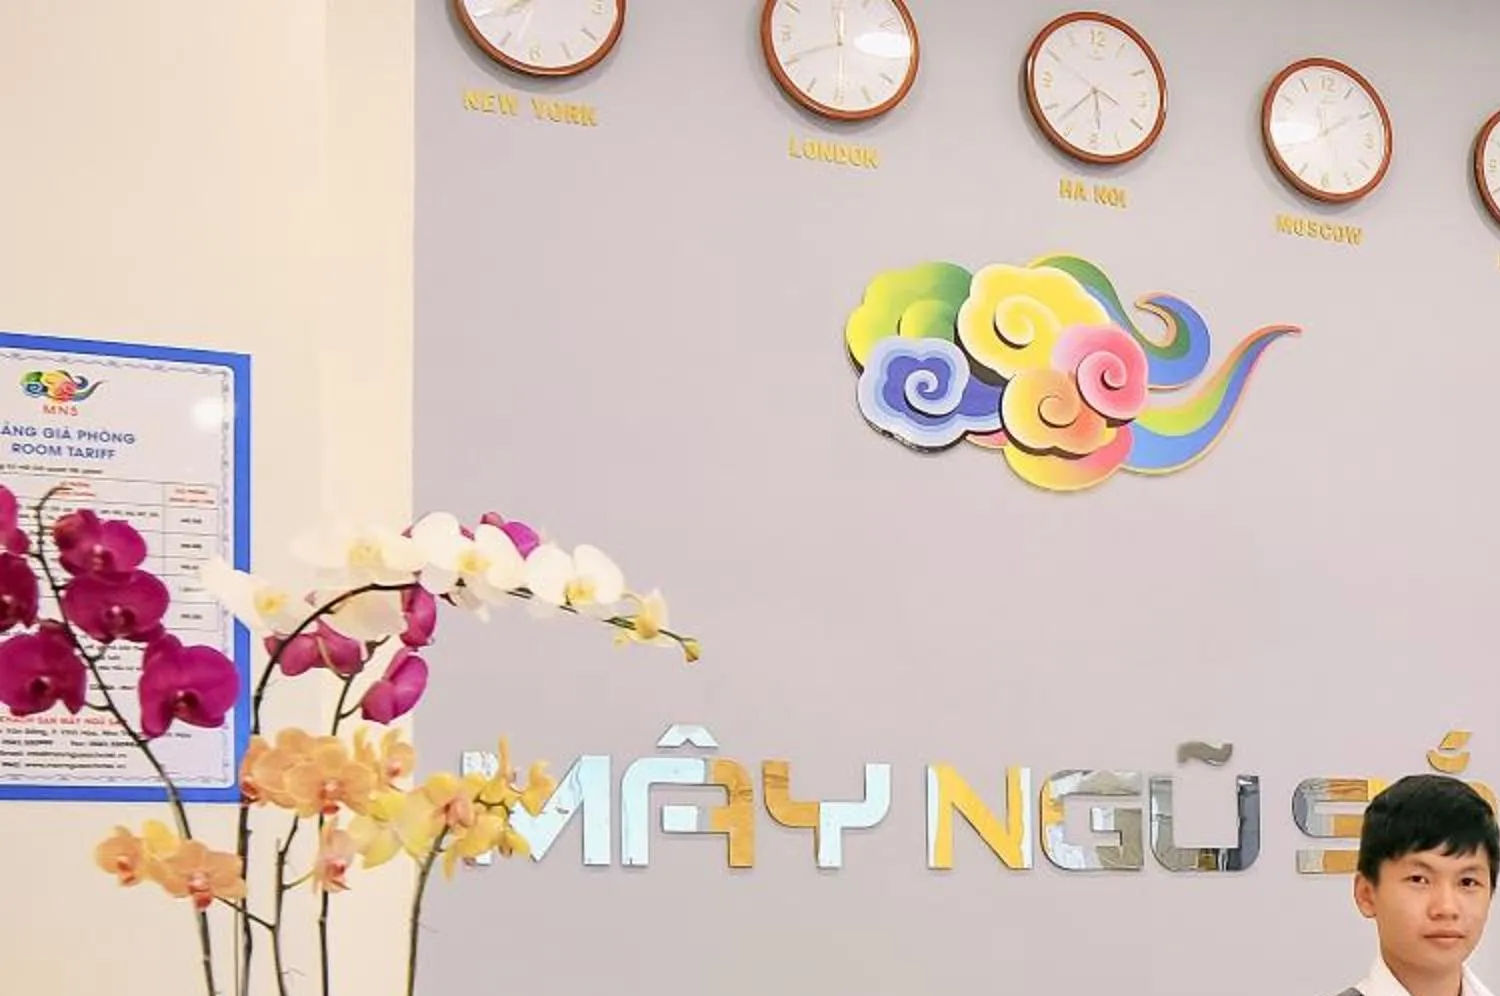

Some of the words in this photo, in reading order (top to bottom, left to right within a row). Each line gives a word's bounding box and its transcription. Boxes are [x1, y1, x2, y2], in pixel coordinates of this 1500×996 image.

[461, 90, 520, 117] NEW
[529, 96, 599, 127] YORK
[788, 133, 879, 169] LONDON
[1059, 178, 1087, 202] HA
[1093, 184, 1129, 210] NOI
[1275, 213, 1364, 245] MOSCOW
[42, 404, 79, 417] MNS
[11, 442, 63, 457] ROOM
[67, 445, 117, 460] TARIFF
[462, 724, 891, 869] MÂY
[926, 740, 1261, 873] NGŨ
